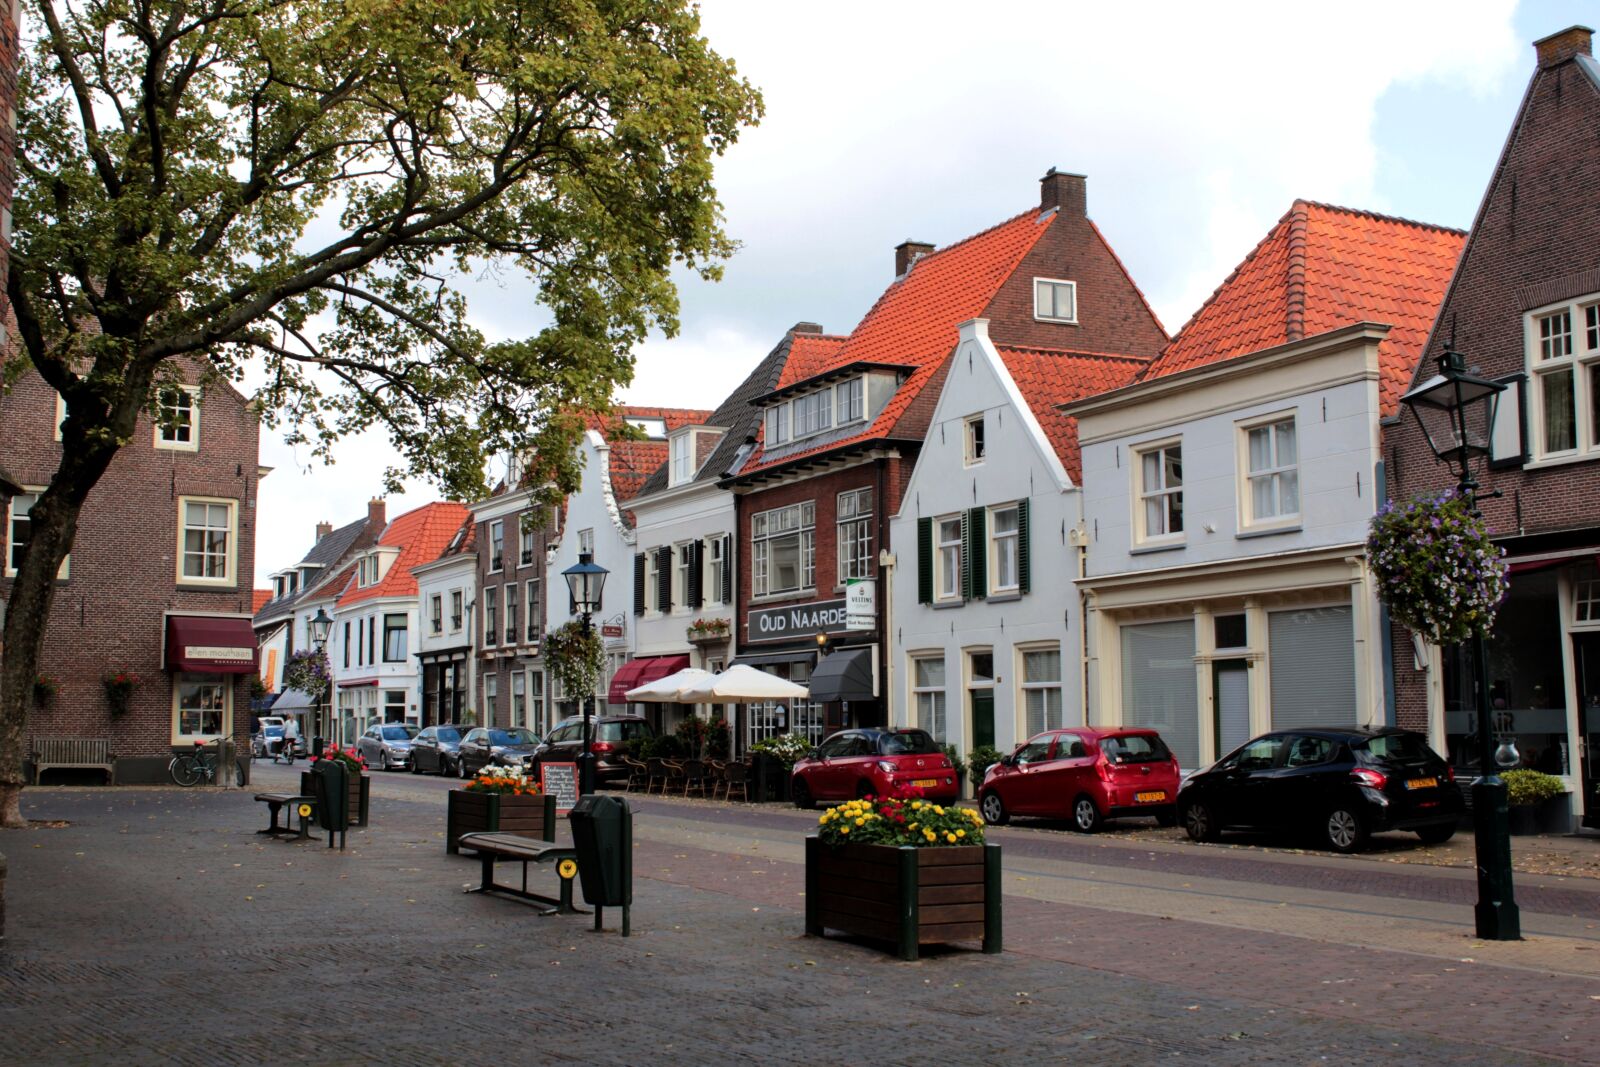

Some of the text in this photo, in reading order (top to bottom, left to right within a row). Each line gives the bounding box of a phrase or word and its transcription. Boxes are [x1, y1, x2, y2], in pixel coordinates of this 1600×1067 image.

[760, 608, 847, 632] OUD NAARDE
[188, 647, 250, 657] ellen mouthaan
